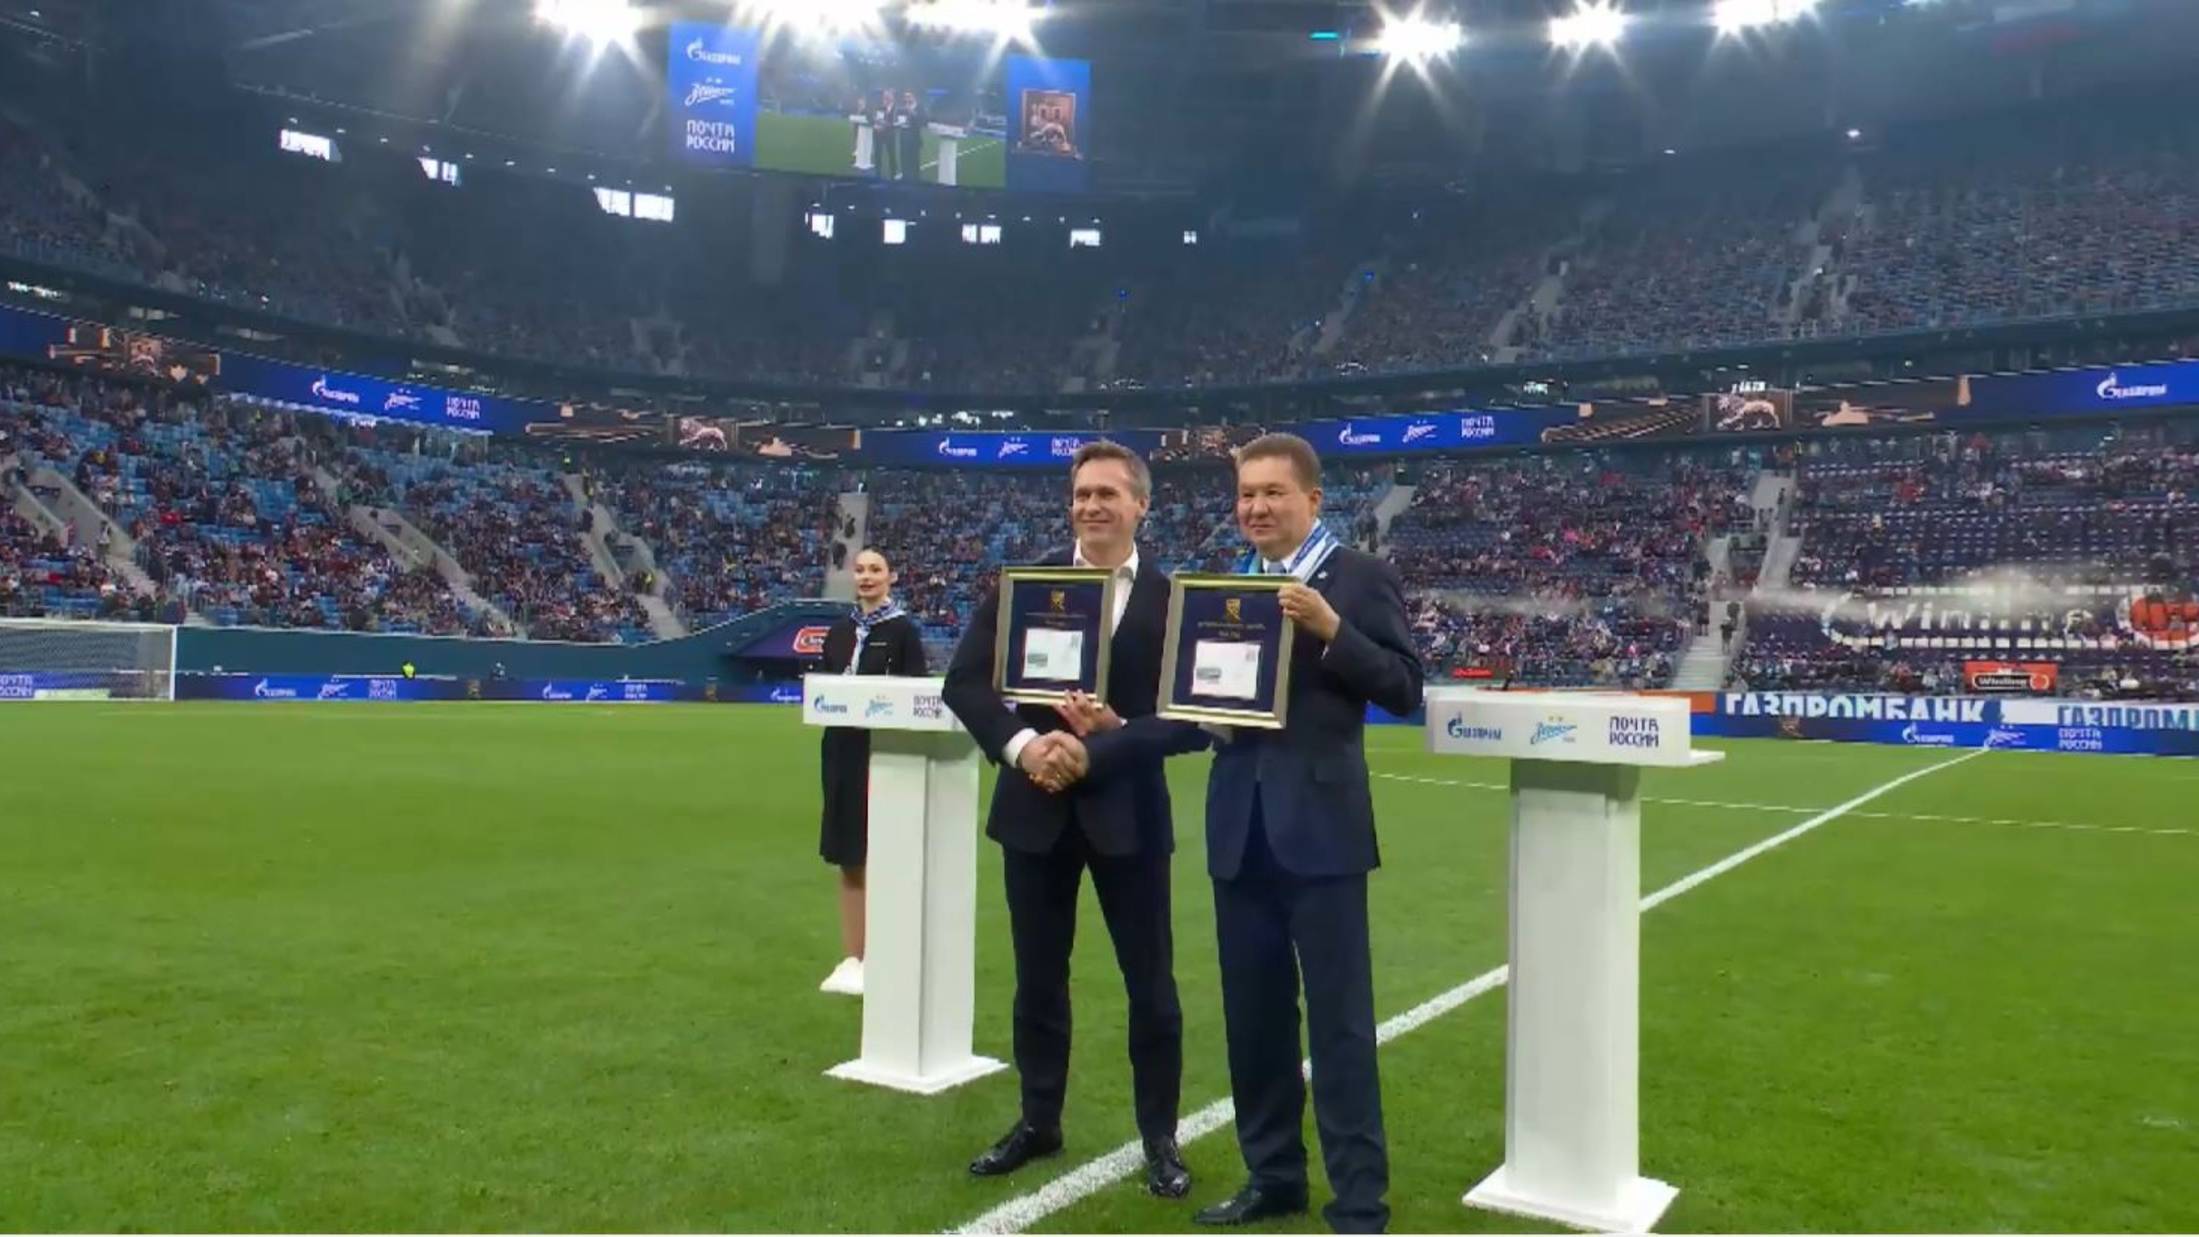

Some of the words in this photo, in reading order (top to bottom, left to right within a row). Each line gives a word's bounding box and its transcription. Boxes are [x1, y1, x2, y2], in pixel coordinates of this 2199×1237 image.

[687, 120, 734, 137] ПОЧТА
[687, 135, 735, 153] РОССИИ
[1610, 716, 1658, 732] ПОЧТА
[1610, 731, 1658, 747] РОССИИ
